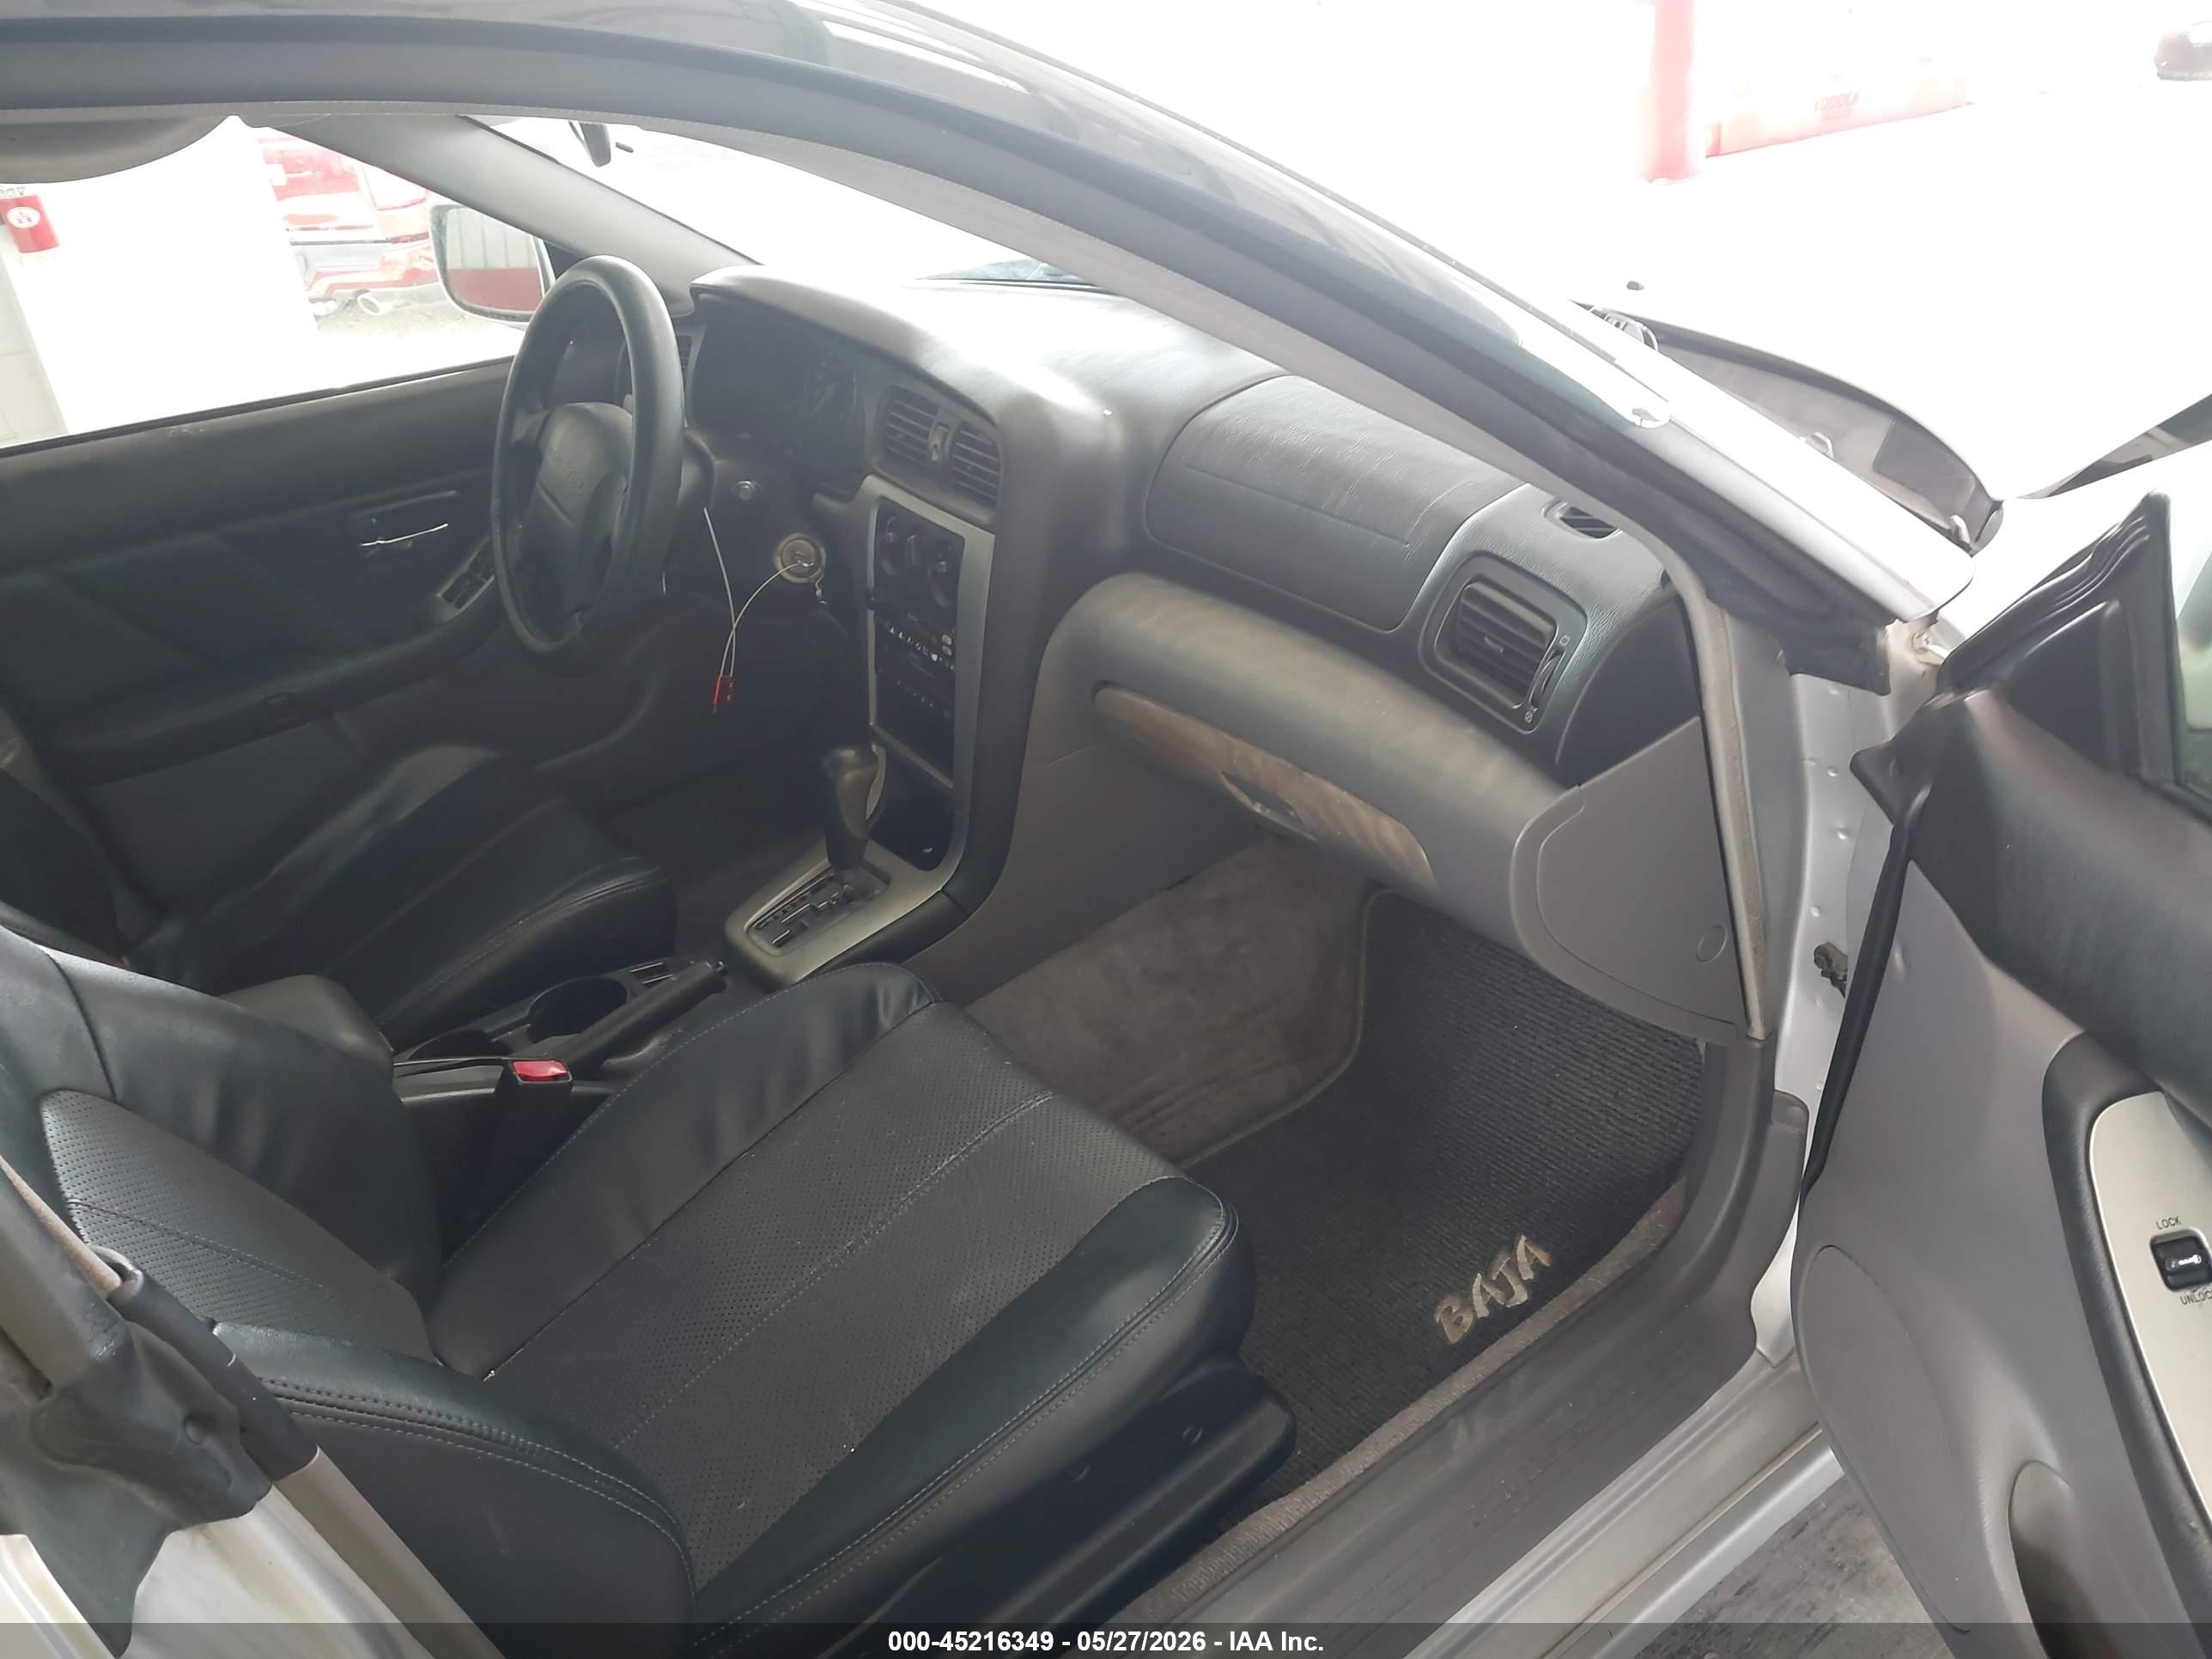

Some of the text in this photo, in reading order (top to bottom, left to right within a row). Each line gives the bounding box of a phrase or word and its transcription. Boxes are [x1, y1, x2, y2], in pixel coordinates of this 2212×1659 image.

[2156, 1215, 2183, 1230] LOCK
[1434, 1235, 1553, 1345] BAJA
[2179, 1290, 2212, 1305] UNLOC
